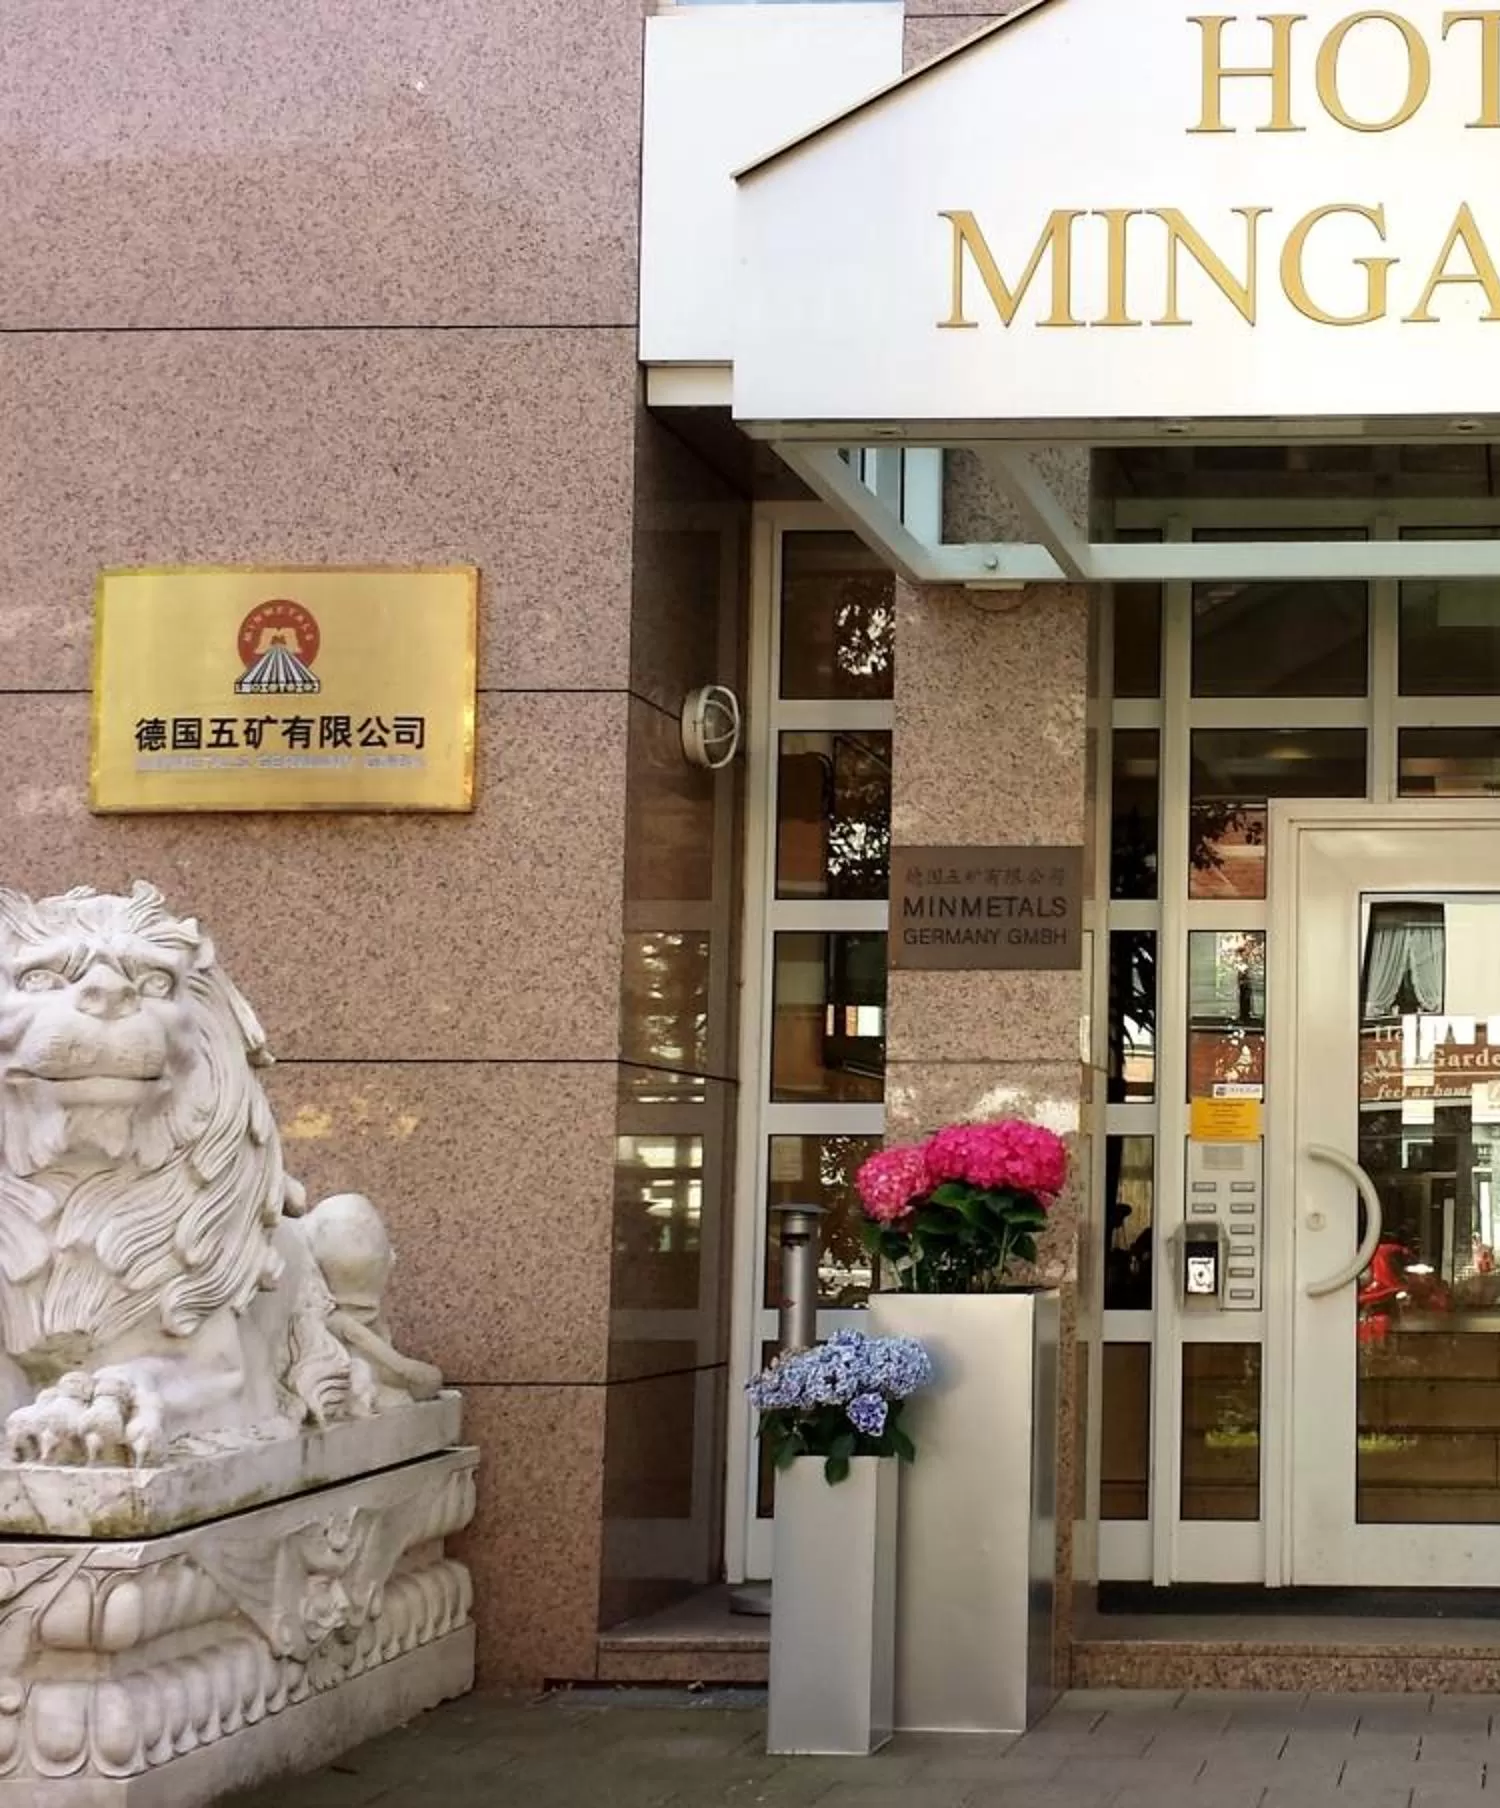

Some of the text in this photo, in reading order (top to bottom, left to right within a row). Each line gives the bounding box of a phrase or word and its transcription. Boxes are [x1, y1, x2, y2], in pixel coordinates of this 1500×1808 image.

[134, 715, 426, 751] 德国五矿有限公司
[903, 896, 1067, 918] MINMETALS
[903, 928, 1001, 944] GERMANY
